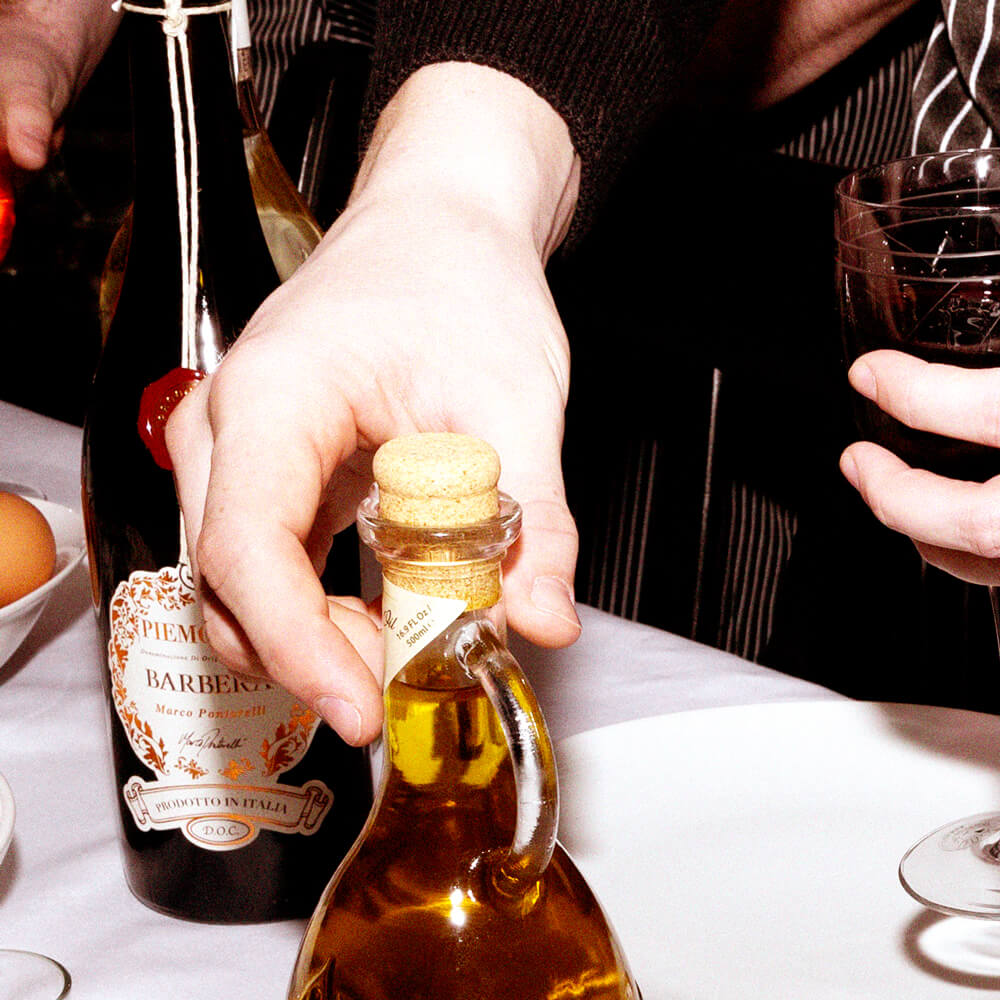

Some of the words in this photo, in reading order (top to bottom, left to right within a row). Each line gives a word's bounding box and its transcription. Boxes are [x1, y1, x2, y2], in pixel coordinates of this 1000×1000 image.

[141, 619, 210, 643] PIEMO
[155, 703, 193, 717] Marco
[155, 798, 221, 813] PRODOTTO
[225, 797, 240, 807] IN
[243, 798, 288, 814] ITALIA
